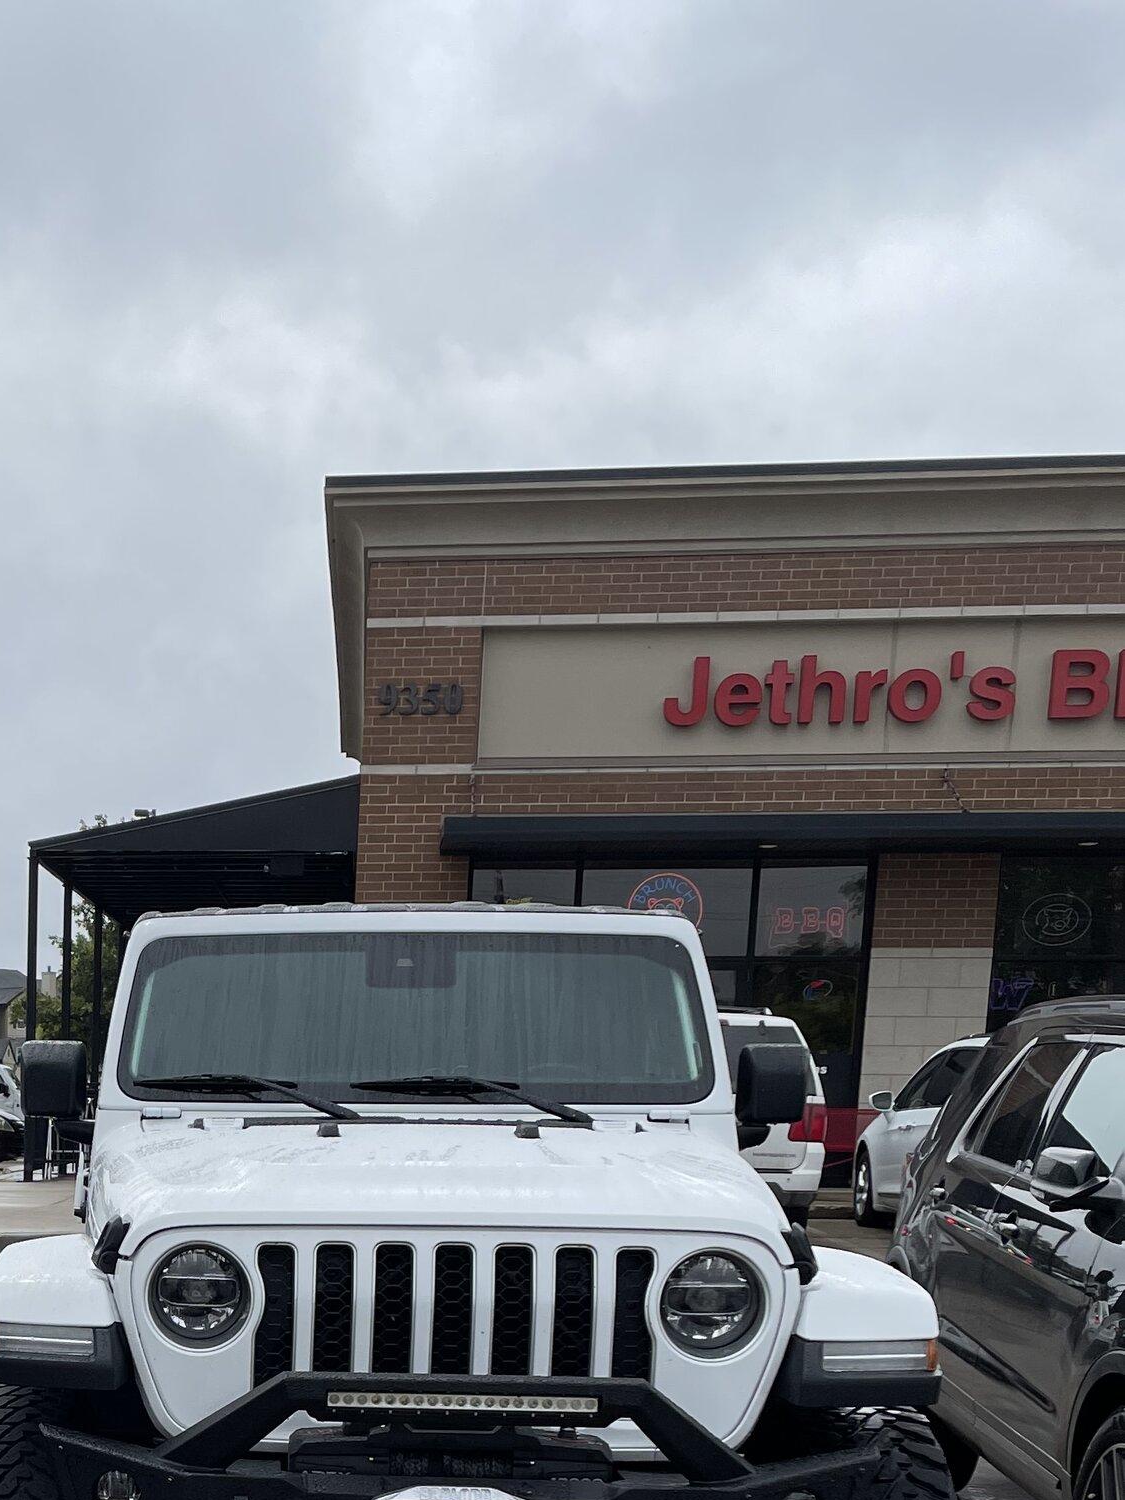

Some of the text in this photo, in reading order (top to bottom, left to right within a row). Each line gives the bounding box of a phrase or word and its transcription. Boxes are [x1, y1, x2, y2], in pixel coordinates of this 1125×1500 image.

[378, 682, 463, 716] 9350
[663, 648, 1125, 727] Jethro's B
[635, 877, 696, 904] BRUNCH
